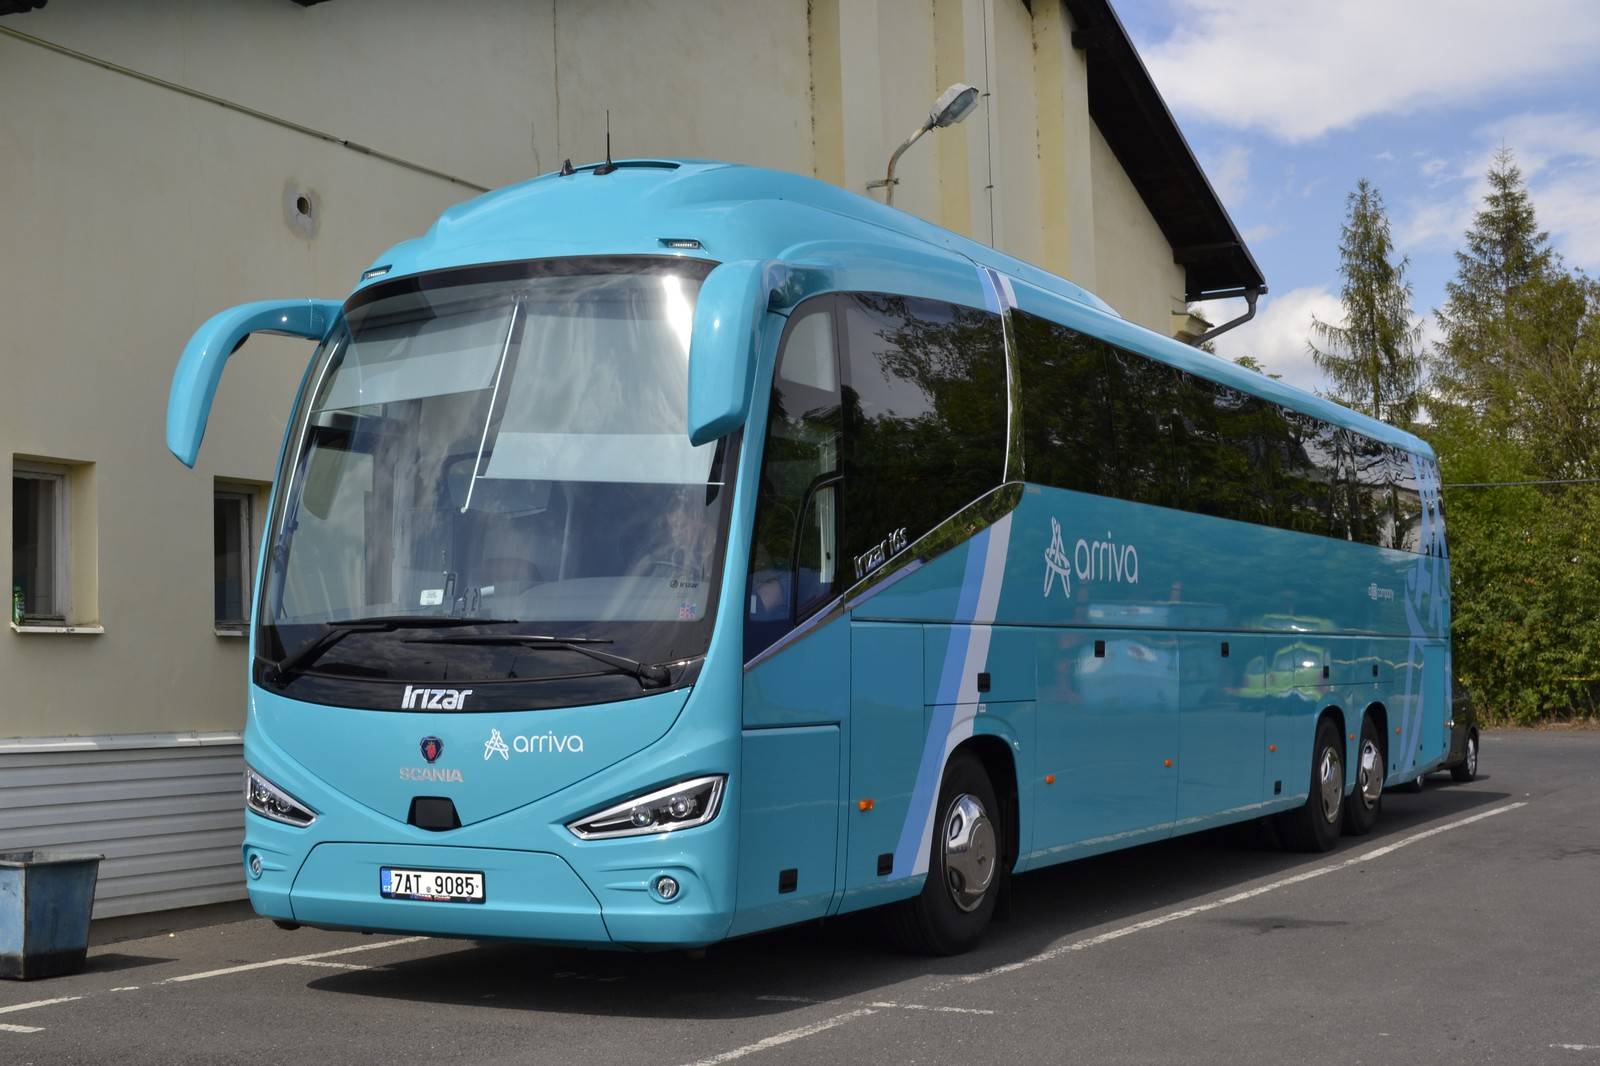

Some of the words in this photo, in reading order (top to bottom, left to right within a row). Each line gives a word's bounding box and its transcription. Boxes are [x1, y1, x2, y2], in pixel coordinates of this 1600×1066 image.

[1075, 531, 1138, 583] arriva
[401, 685, 472, 710] Irizar
[513, 730, 584, 752] arriva
[400, 767, 463, 782] SCANIA
[394, 873, 422, 893] 7AT
[434, 876, 474, 895] 9085
